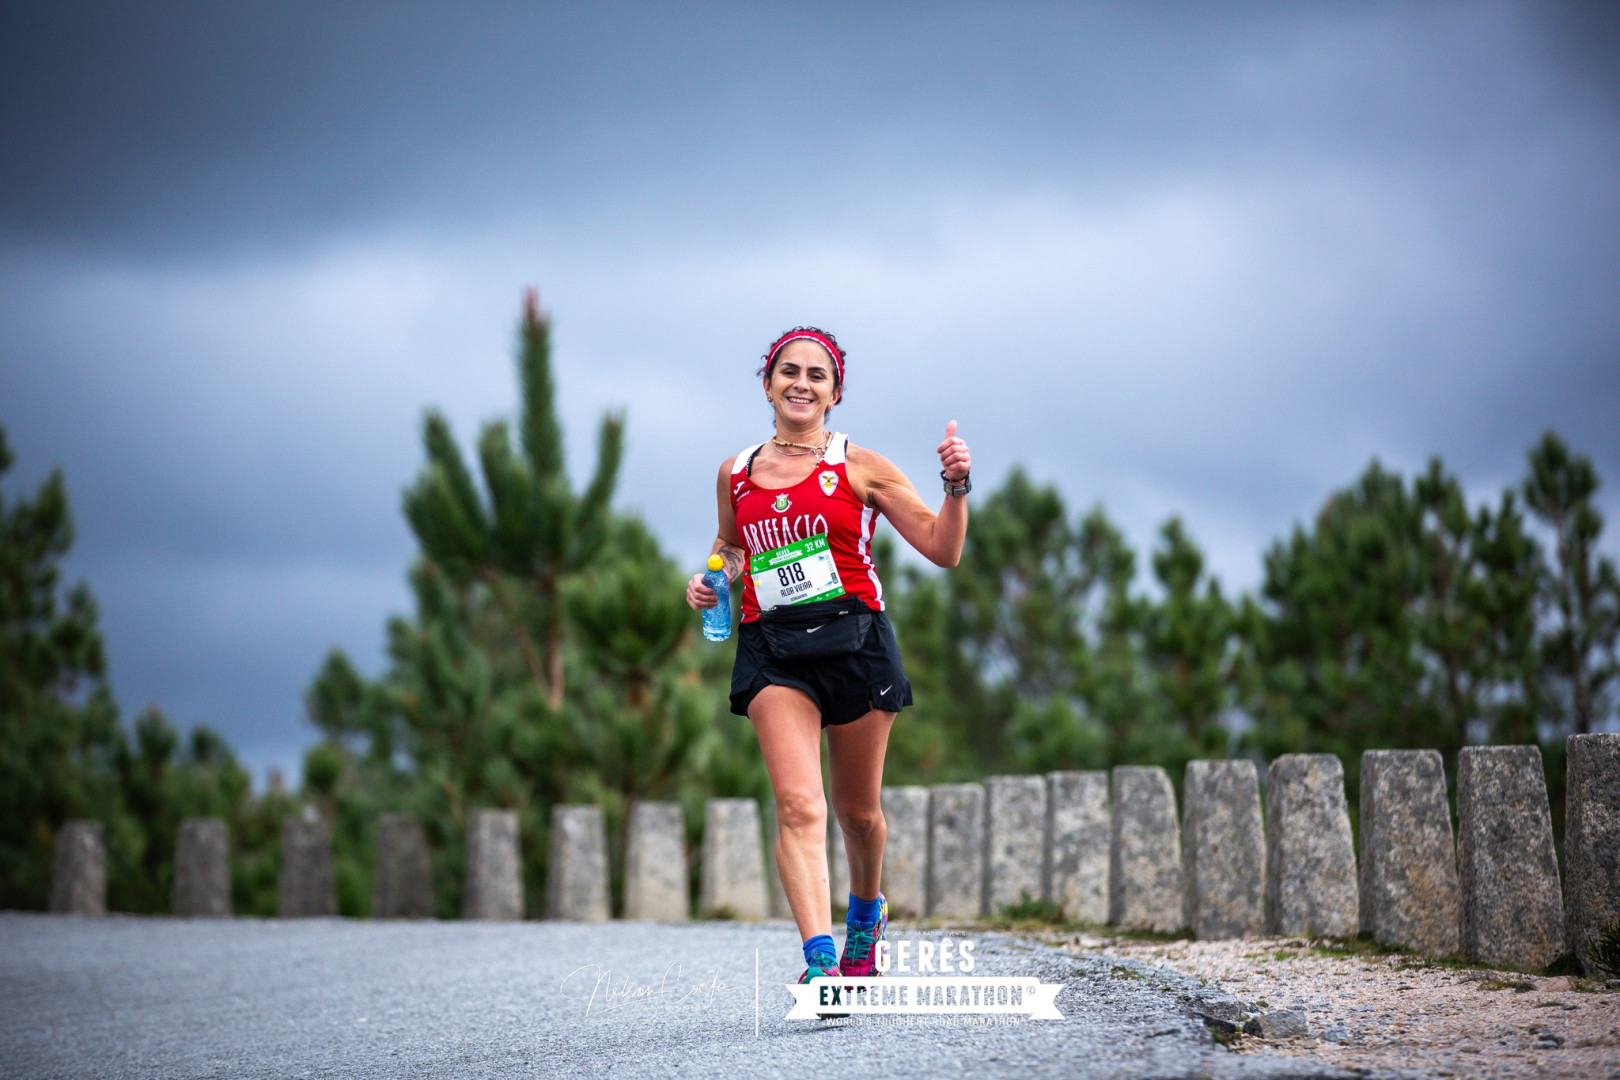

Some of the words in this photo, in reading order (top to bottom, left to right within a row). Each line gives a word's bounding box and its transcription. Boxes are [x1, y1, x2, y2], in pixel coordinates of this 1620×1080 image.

[804, 541, 815, 552] 32
[814, 538, 826, 550] KM
[777, 562, 806, 587] 818
[780, 586, 795, 597] ALDA
[794, 580, 813, 593] VIEIRA
